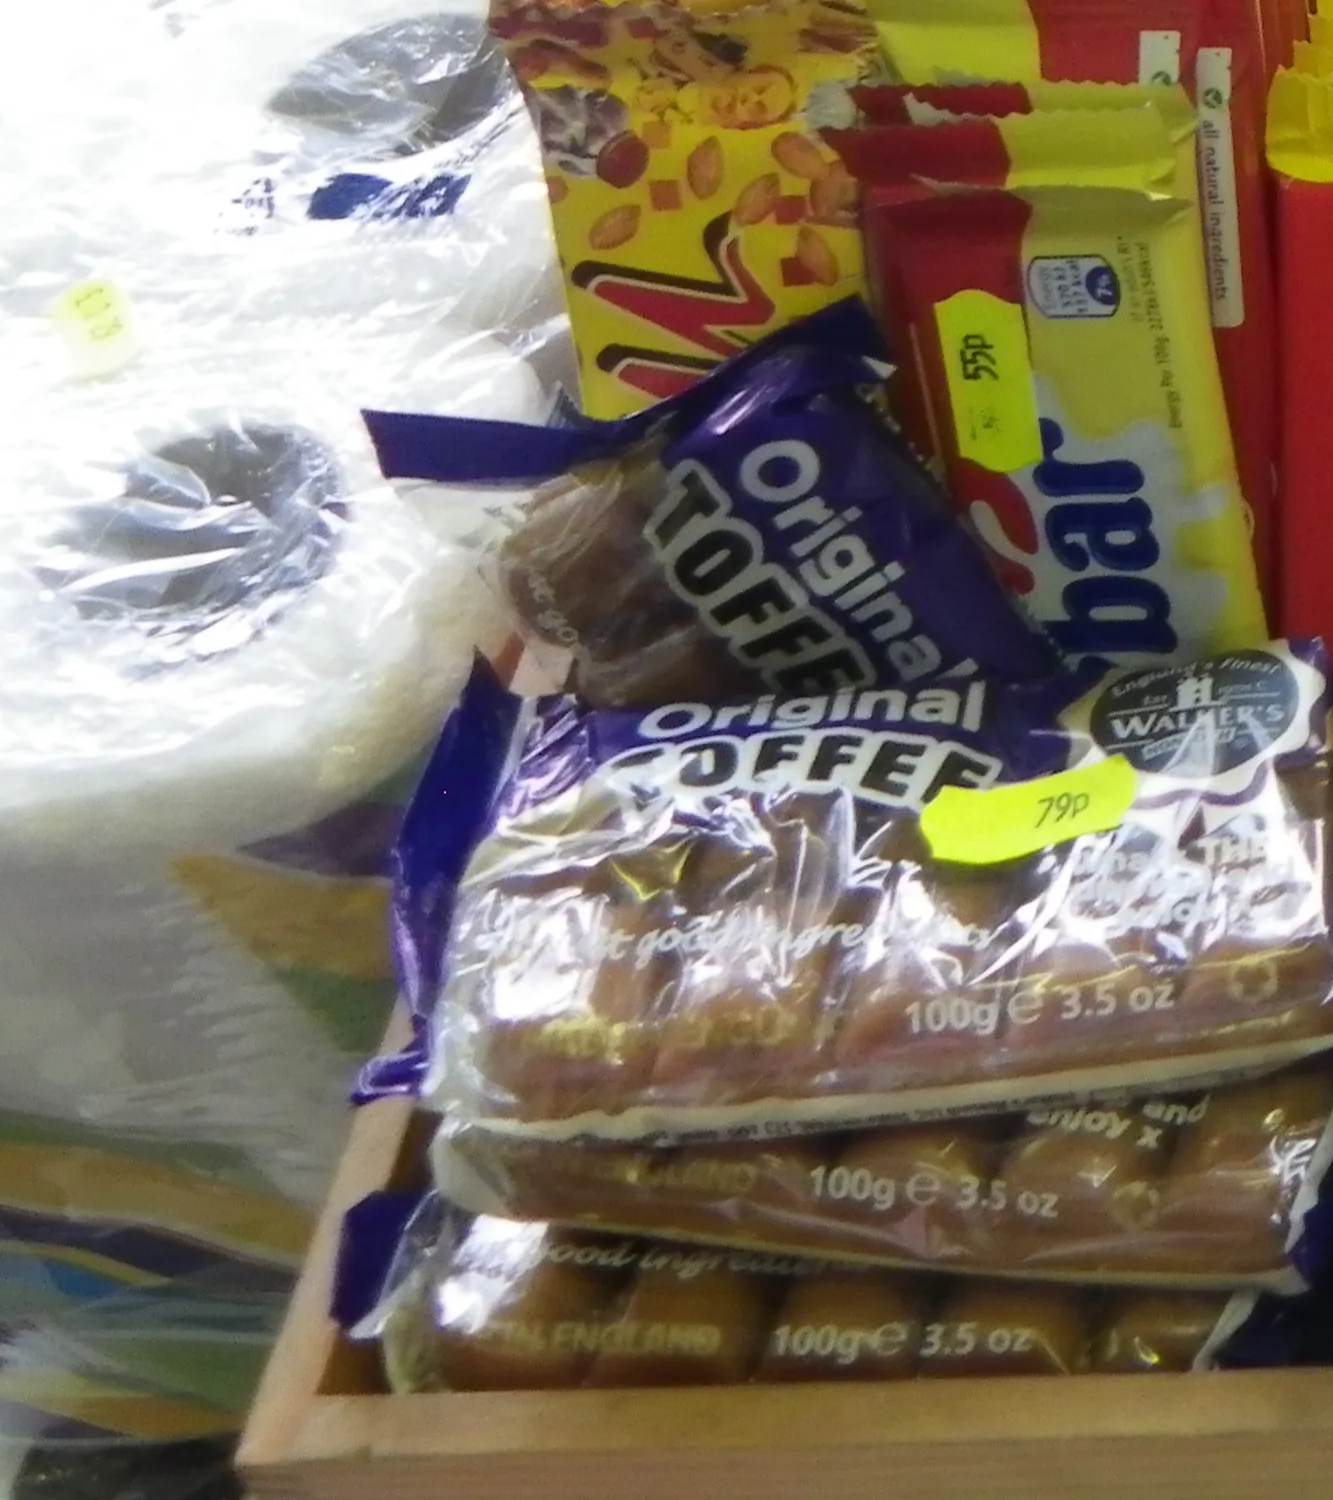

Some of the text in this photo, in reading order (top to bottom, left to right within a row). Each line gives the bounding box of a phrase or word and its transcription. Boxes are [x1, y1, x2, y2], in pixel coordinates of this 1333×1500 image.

[1201, 120, 1230, 301] all natural ingredients
[962, 333, 1000, 381] 55p
[638, 682, 984, 741] Original
[1109, 702, 1286, 739] WALKER'S
[1037, 790, 1089, 828] 79p
[905, 982, 1175, 1037] 100g 3.5 oz
[809, 1167, 1059, 1219] 100g 3.5 oz
